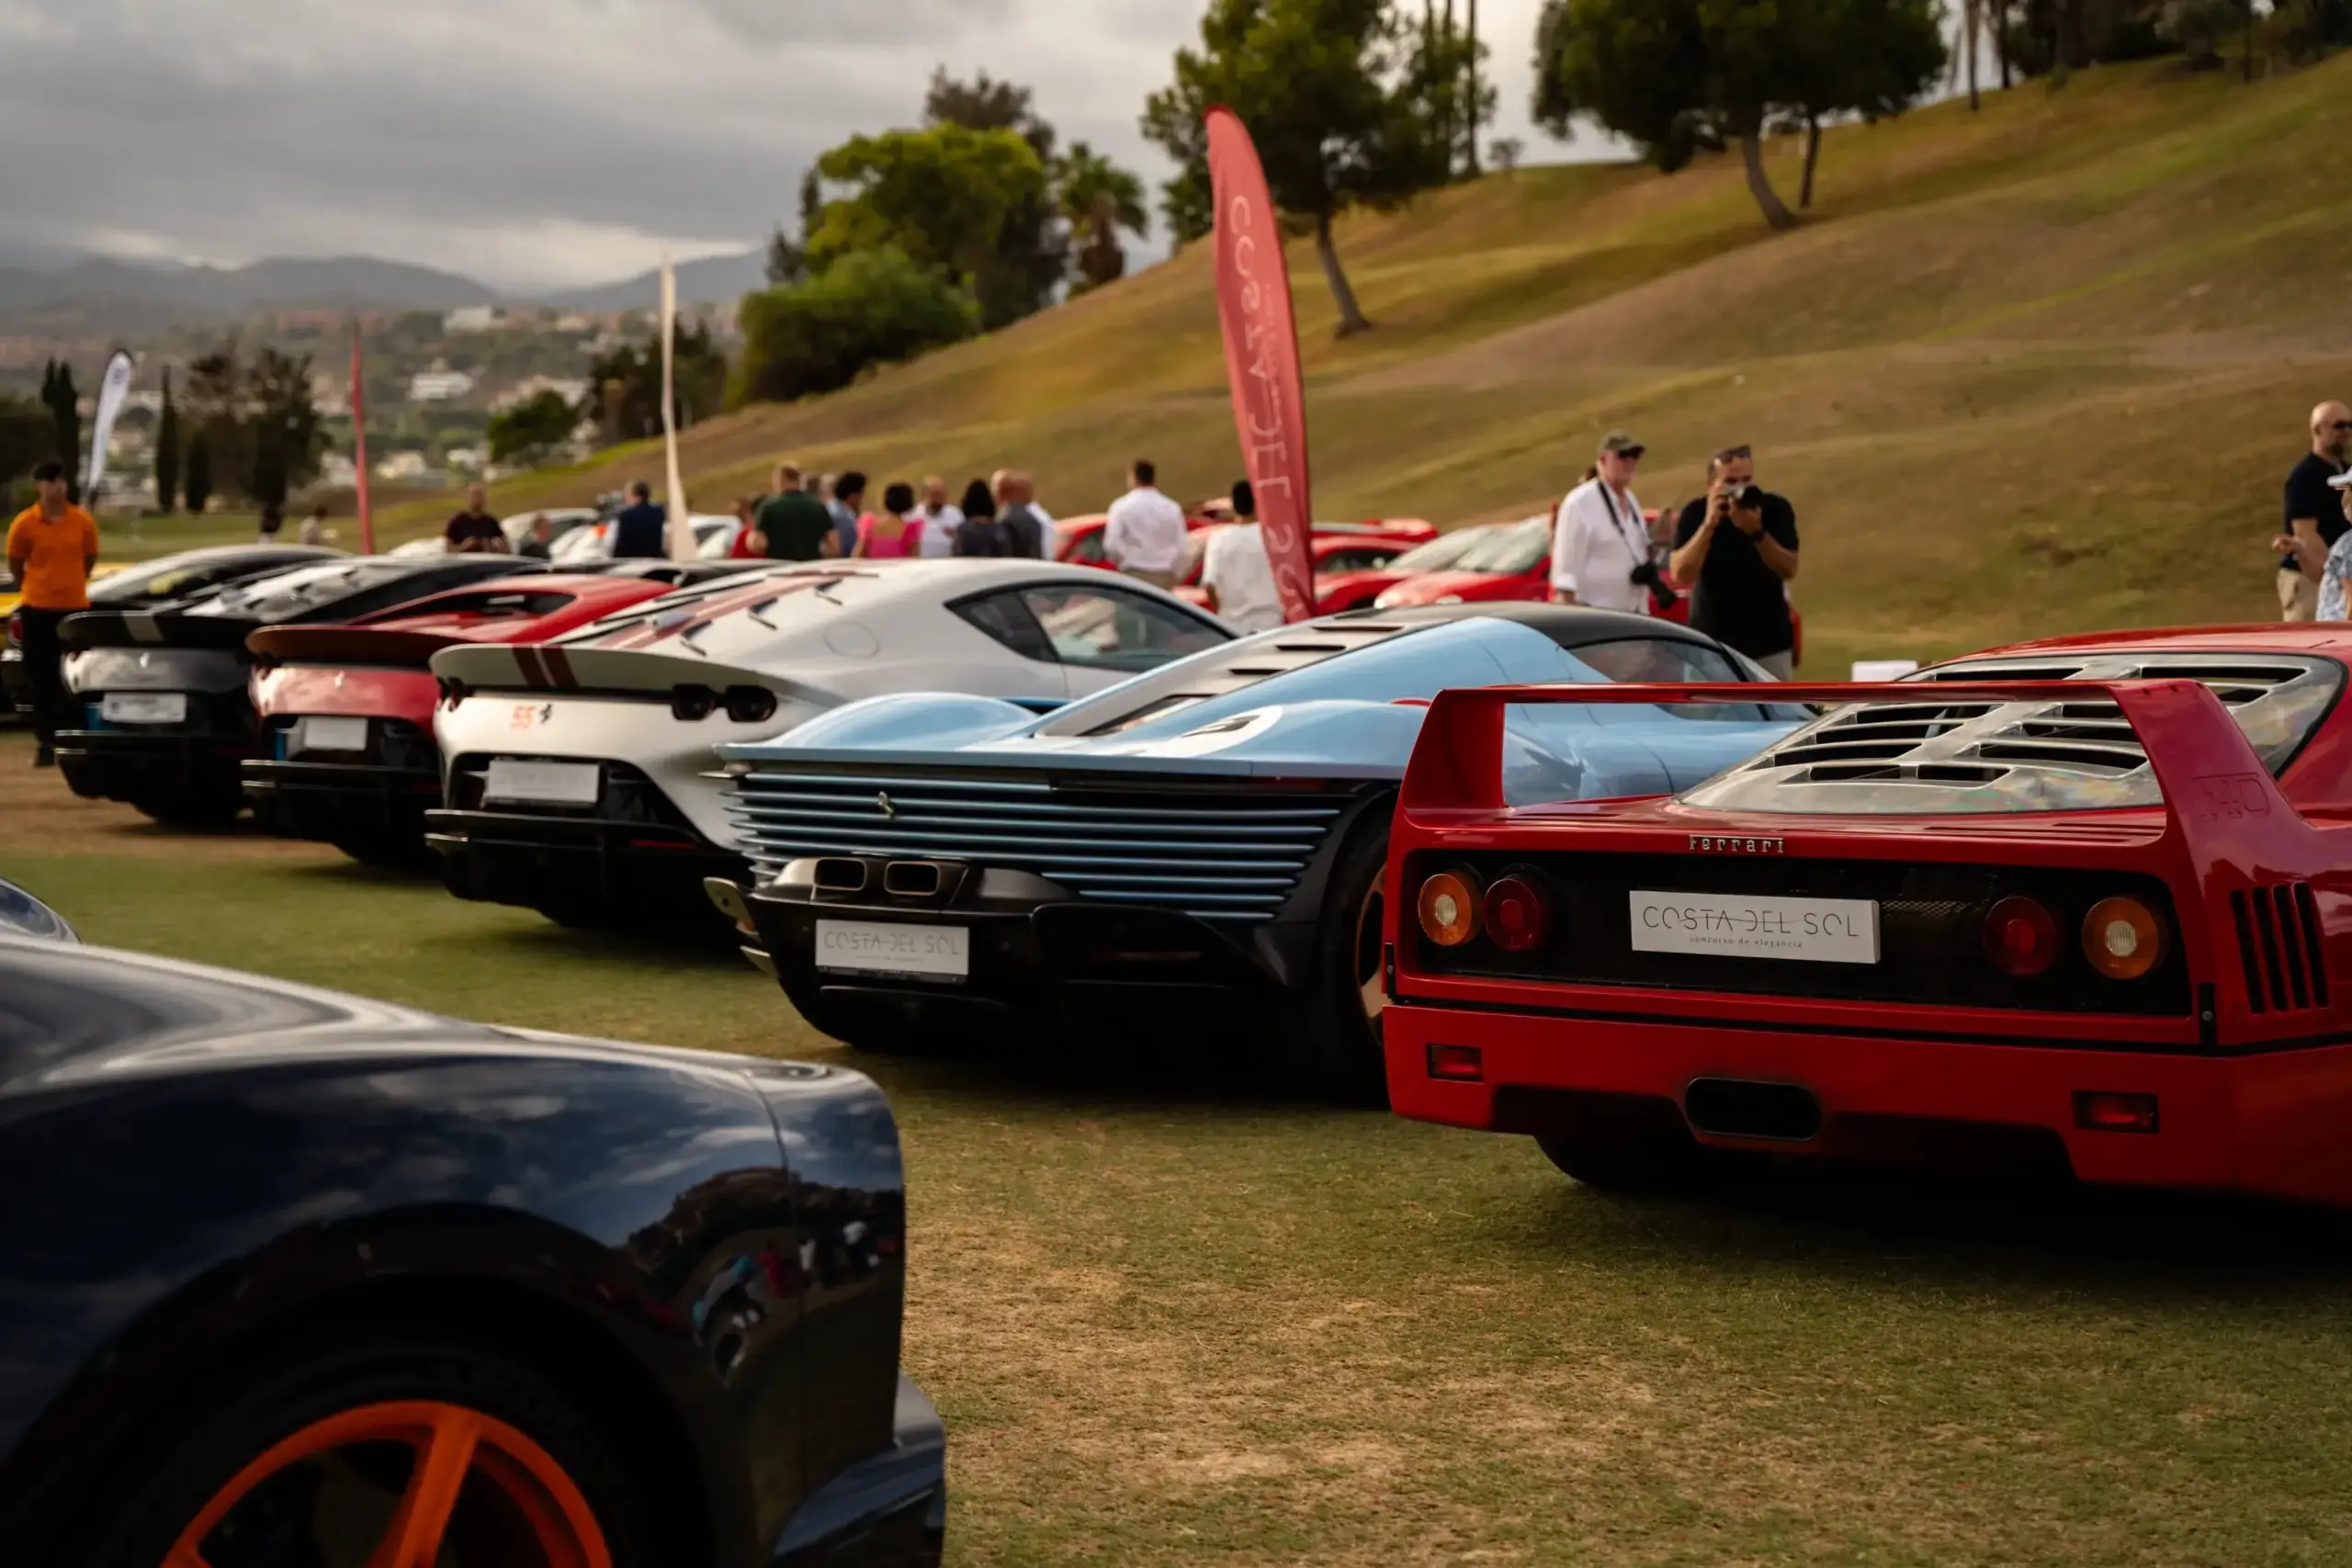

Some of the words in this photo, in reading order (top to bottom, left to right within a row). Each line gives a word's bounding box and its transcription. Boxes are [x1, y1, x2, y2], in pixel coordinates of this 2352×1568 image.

[1690, 835, 1784, 853] Ferrari
[1643, 906, 1734, 931] COSTA
[1744, 909, 1792, 933] DEL
[1804, 912, 1860, 937] SOL
[824, 931, 882, 951] COSTA
[888, 934, 917, 953] DEL
[924, 935, 960, 955] SOL
